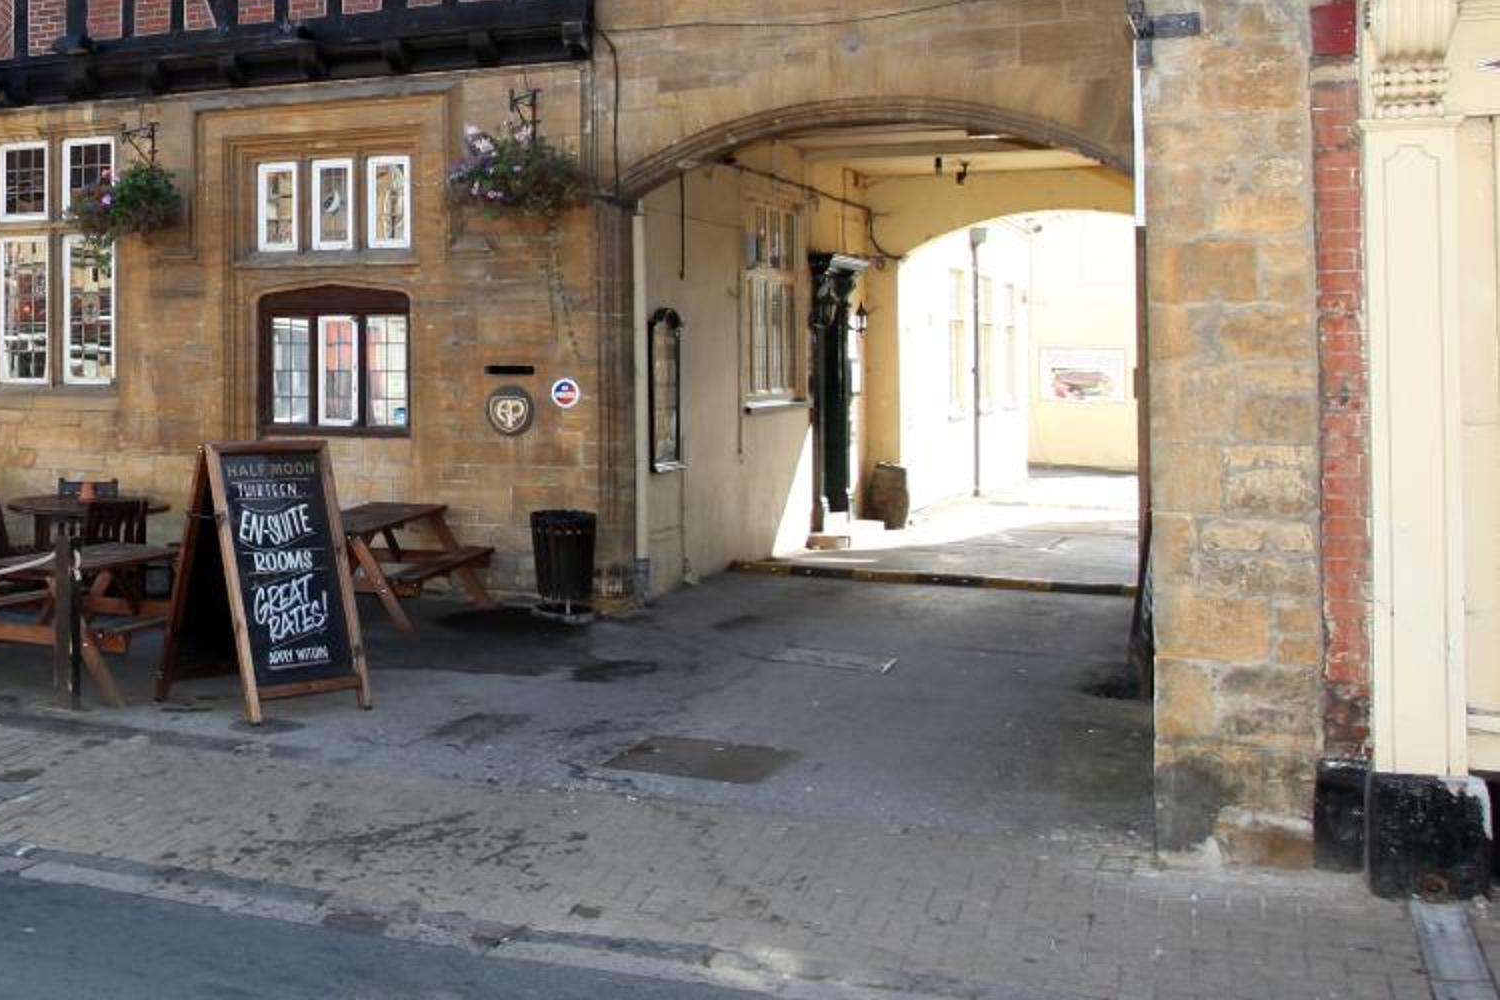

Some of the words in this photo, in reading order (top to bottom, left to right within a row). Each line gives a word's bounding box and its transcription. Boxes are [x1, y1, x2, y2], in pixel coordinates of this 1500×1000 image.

[239, 503, 313, 545] EN-SUITE
[253, 550, 313, 572] ROOMS
[254, 573, 313, 625] GREAT
[268, 590, 329, 643] RATES!
